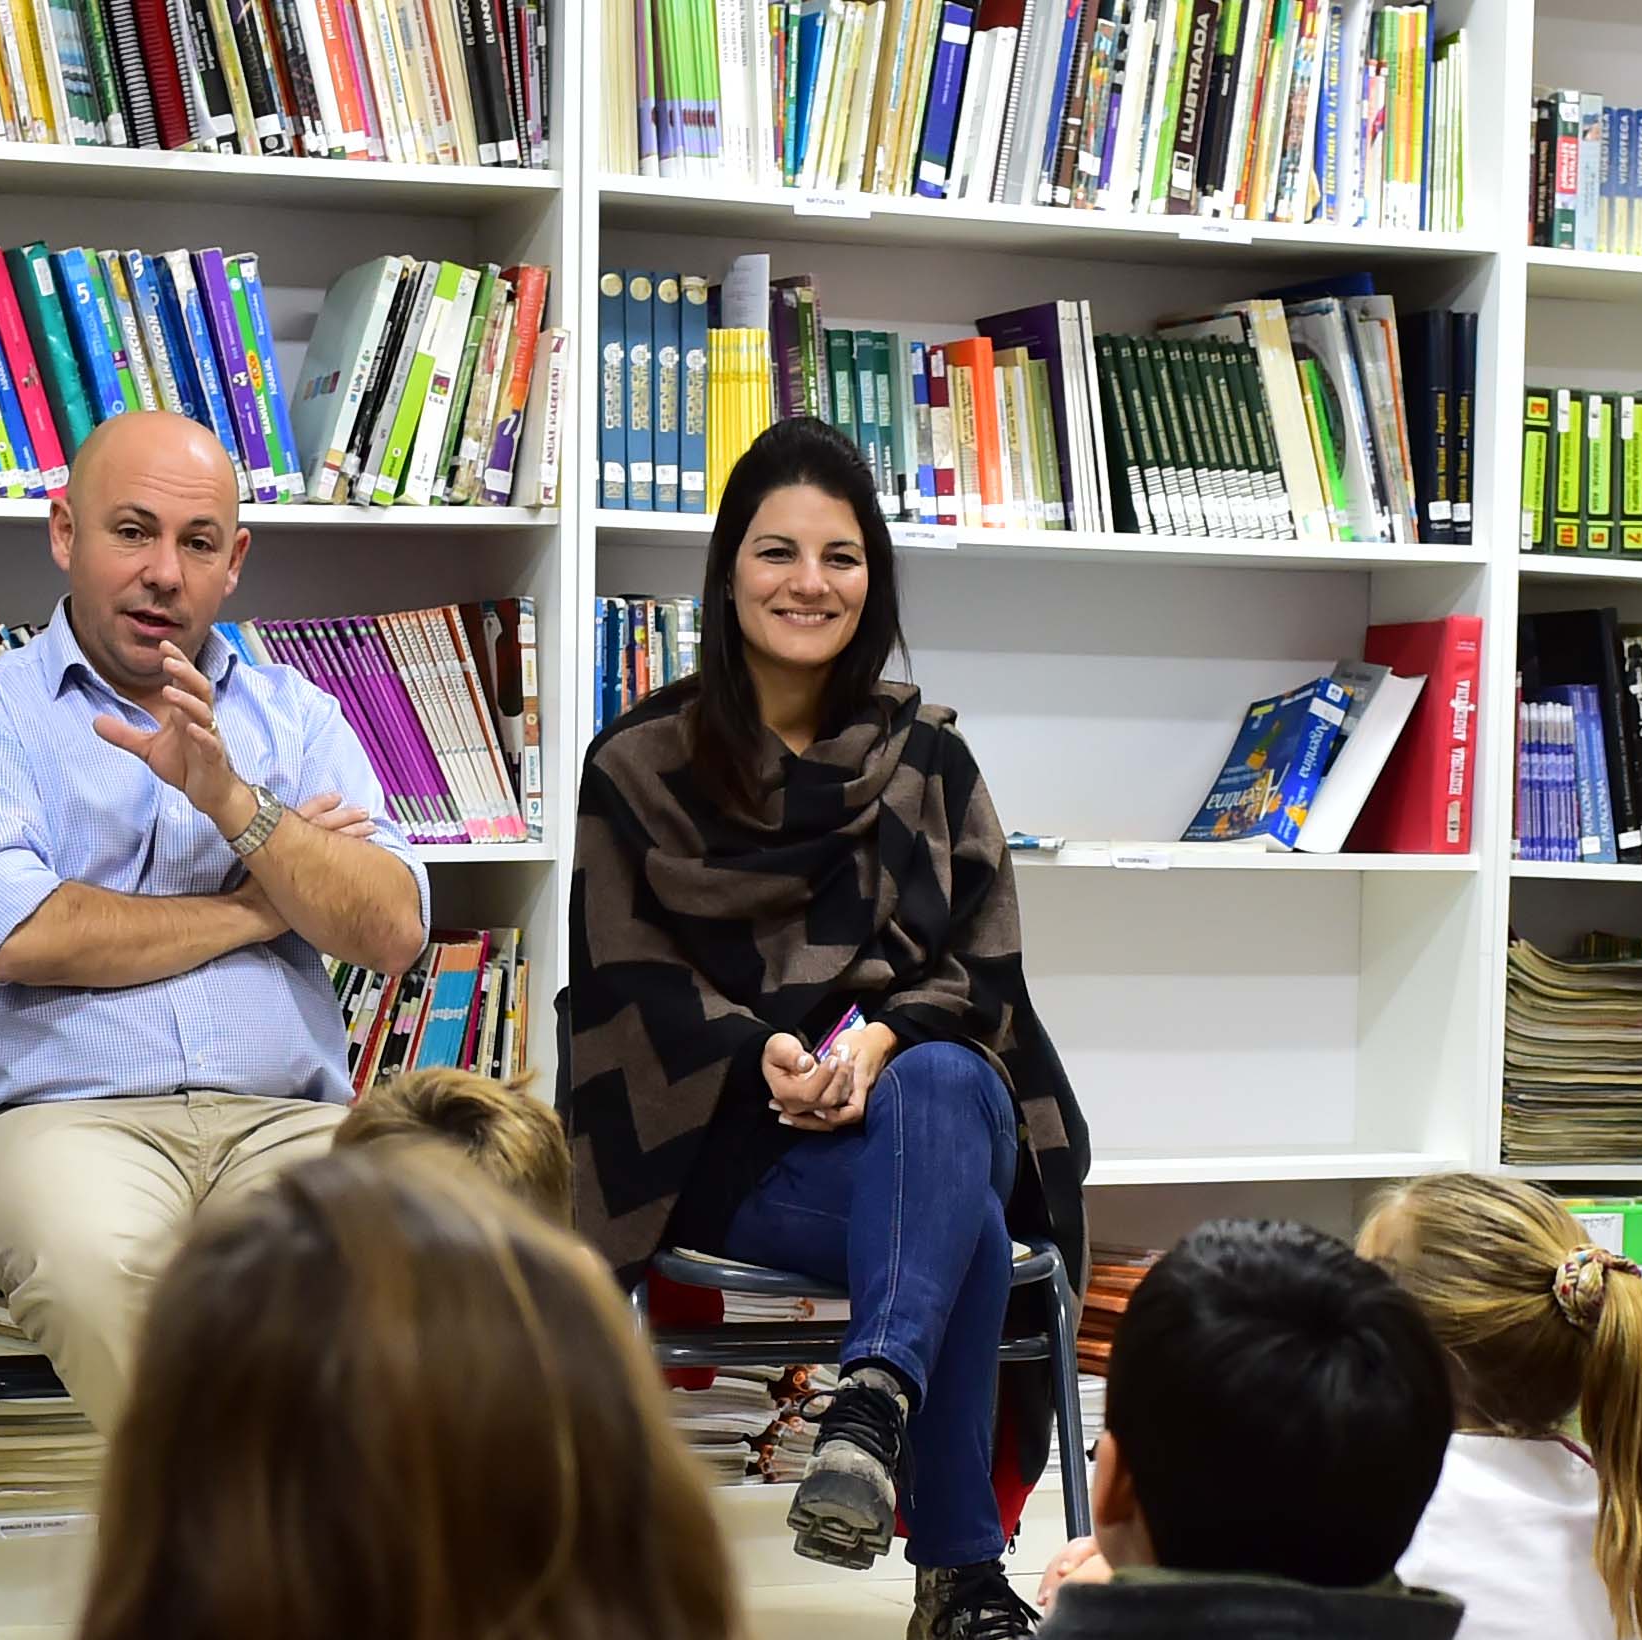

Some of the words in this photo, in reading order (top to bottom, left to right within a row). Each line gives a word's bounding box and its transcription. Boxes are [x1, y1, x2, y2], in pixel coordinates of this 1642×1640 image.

[1180, 13, 1211, 142] ILUSTRADA
[1619, 114, 1630, 185] VIDEOTECA
[132, 260, 145, 279] 5
[76, 283, 91, 304] 5
[256, 394, 272, 435] MANUAL
[1436, 393, 1448, 434] Argentina
[1458, 396, 1469, 437] Argentina
[1299, 720, 1331, 779] Argentina
[531, 800, 539, 814] 9
